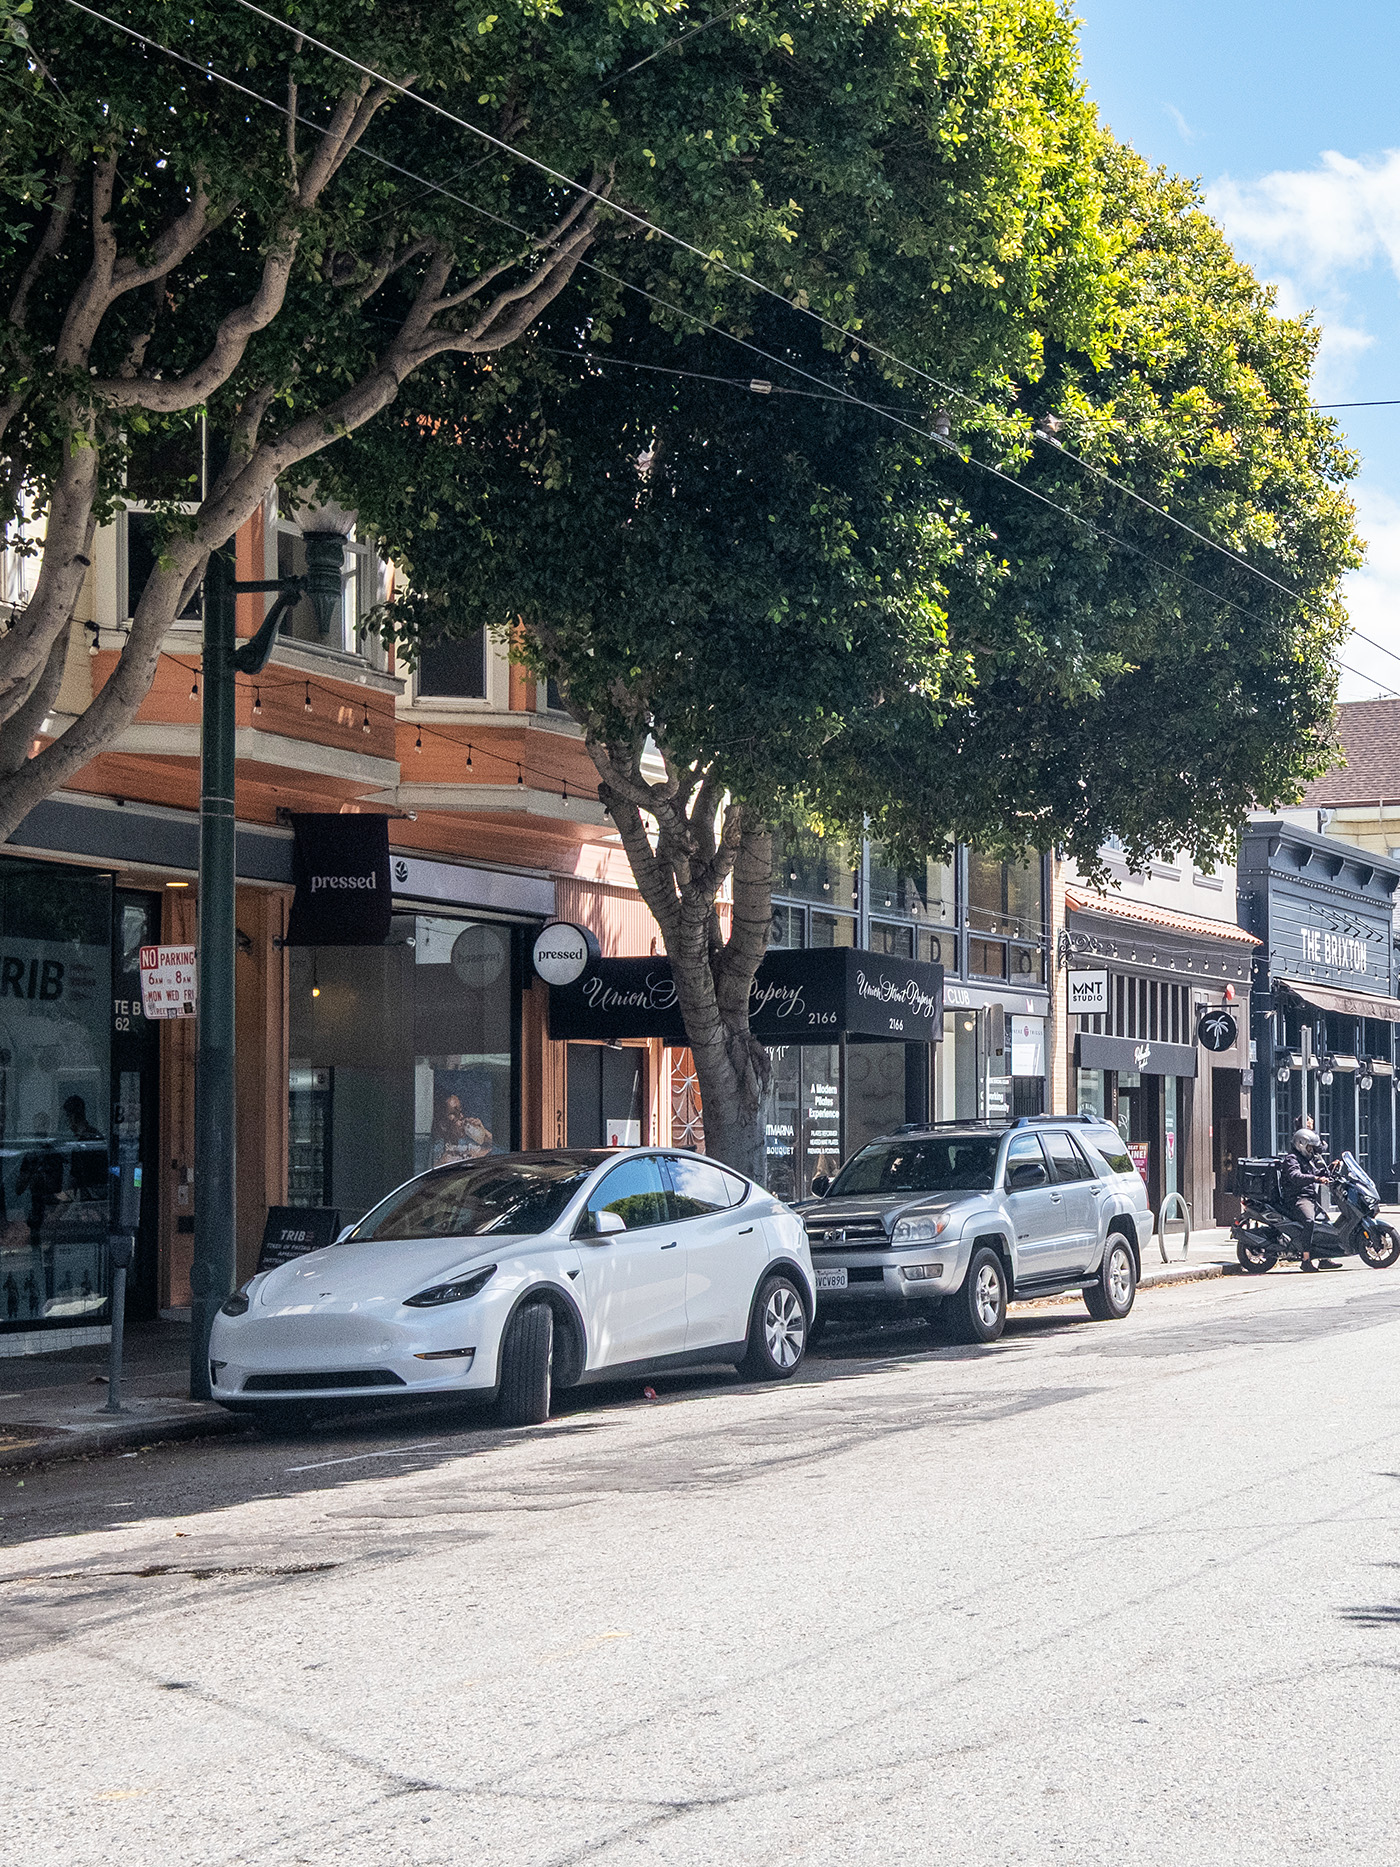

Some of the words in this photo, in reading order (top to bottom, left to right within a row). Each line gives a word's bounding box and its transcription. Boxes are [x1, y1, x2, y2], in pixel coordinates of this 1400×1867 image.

[310, 871, 377, 893] pressed
[538, 948, 583, 962] pressed
[1300, 927, 1321, 962] THE
[1324, 933, 1367, 973] BRIXTON
[142, 949, 157, 968] NO
[160, 952, 195, 966] PARKING
[583, 977, 655, 1012] Union
[1073, 981, 1103, 995] MNT
[147, 990, 163, 1002] MON
[166, 989, 180, 1001] WED
[184, 989, 195, 1001] FRI
[947, 988, 970, 1005] CLUB
[132, 1001, 141, 1015] B
[808, 1012, 837, 1024] 2166
[888, 1018, 904, 1031] 2166
[810, 1083, 816, 1094] A
[816, 1084, 838, 1094] Modern
[814, 1096, 834, 1106] Pilates
[808, 1108, 840, 1120] Experience
[766, 1146, 795, 1155] BOUQUET
